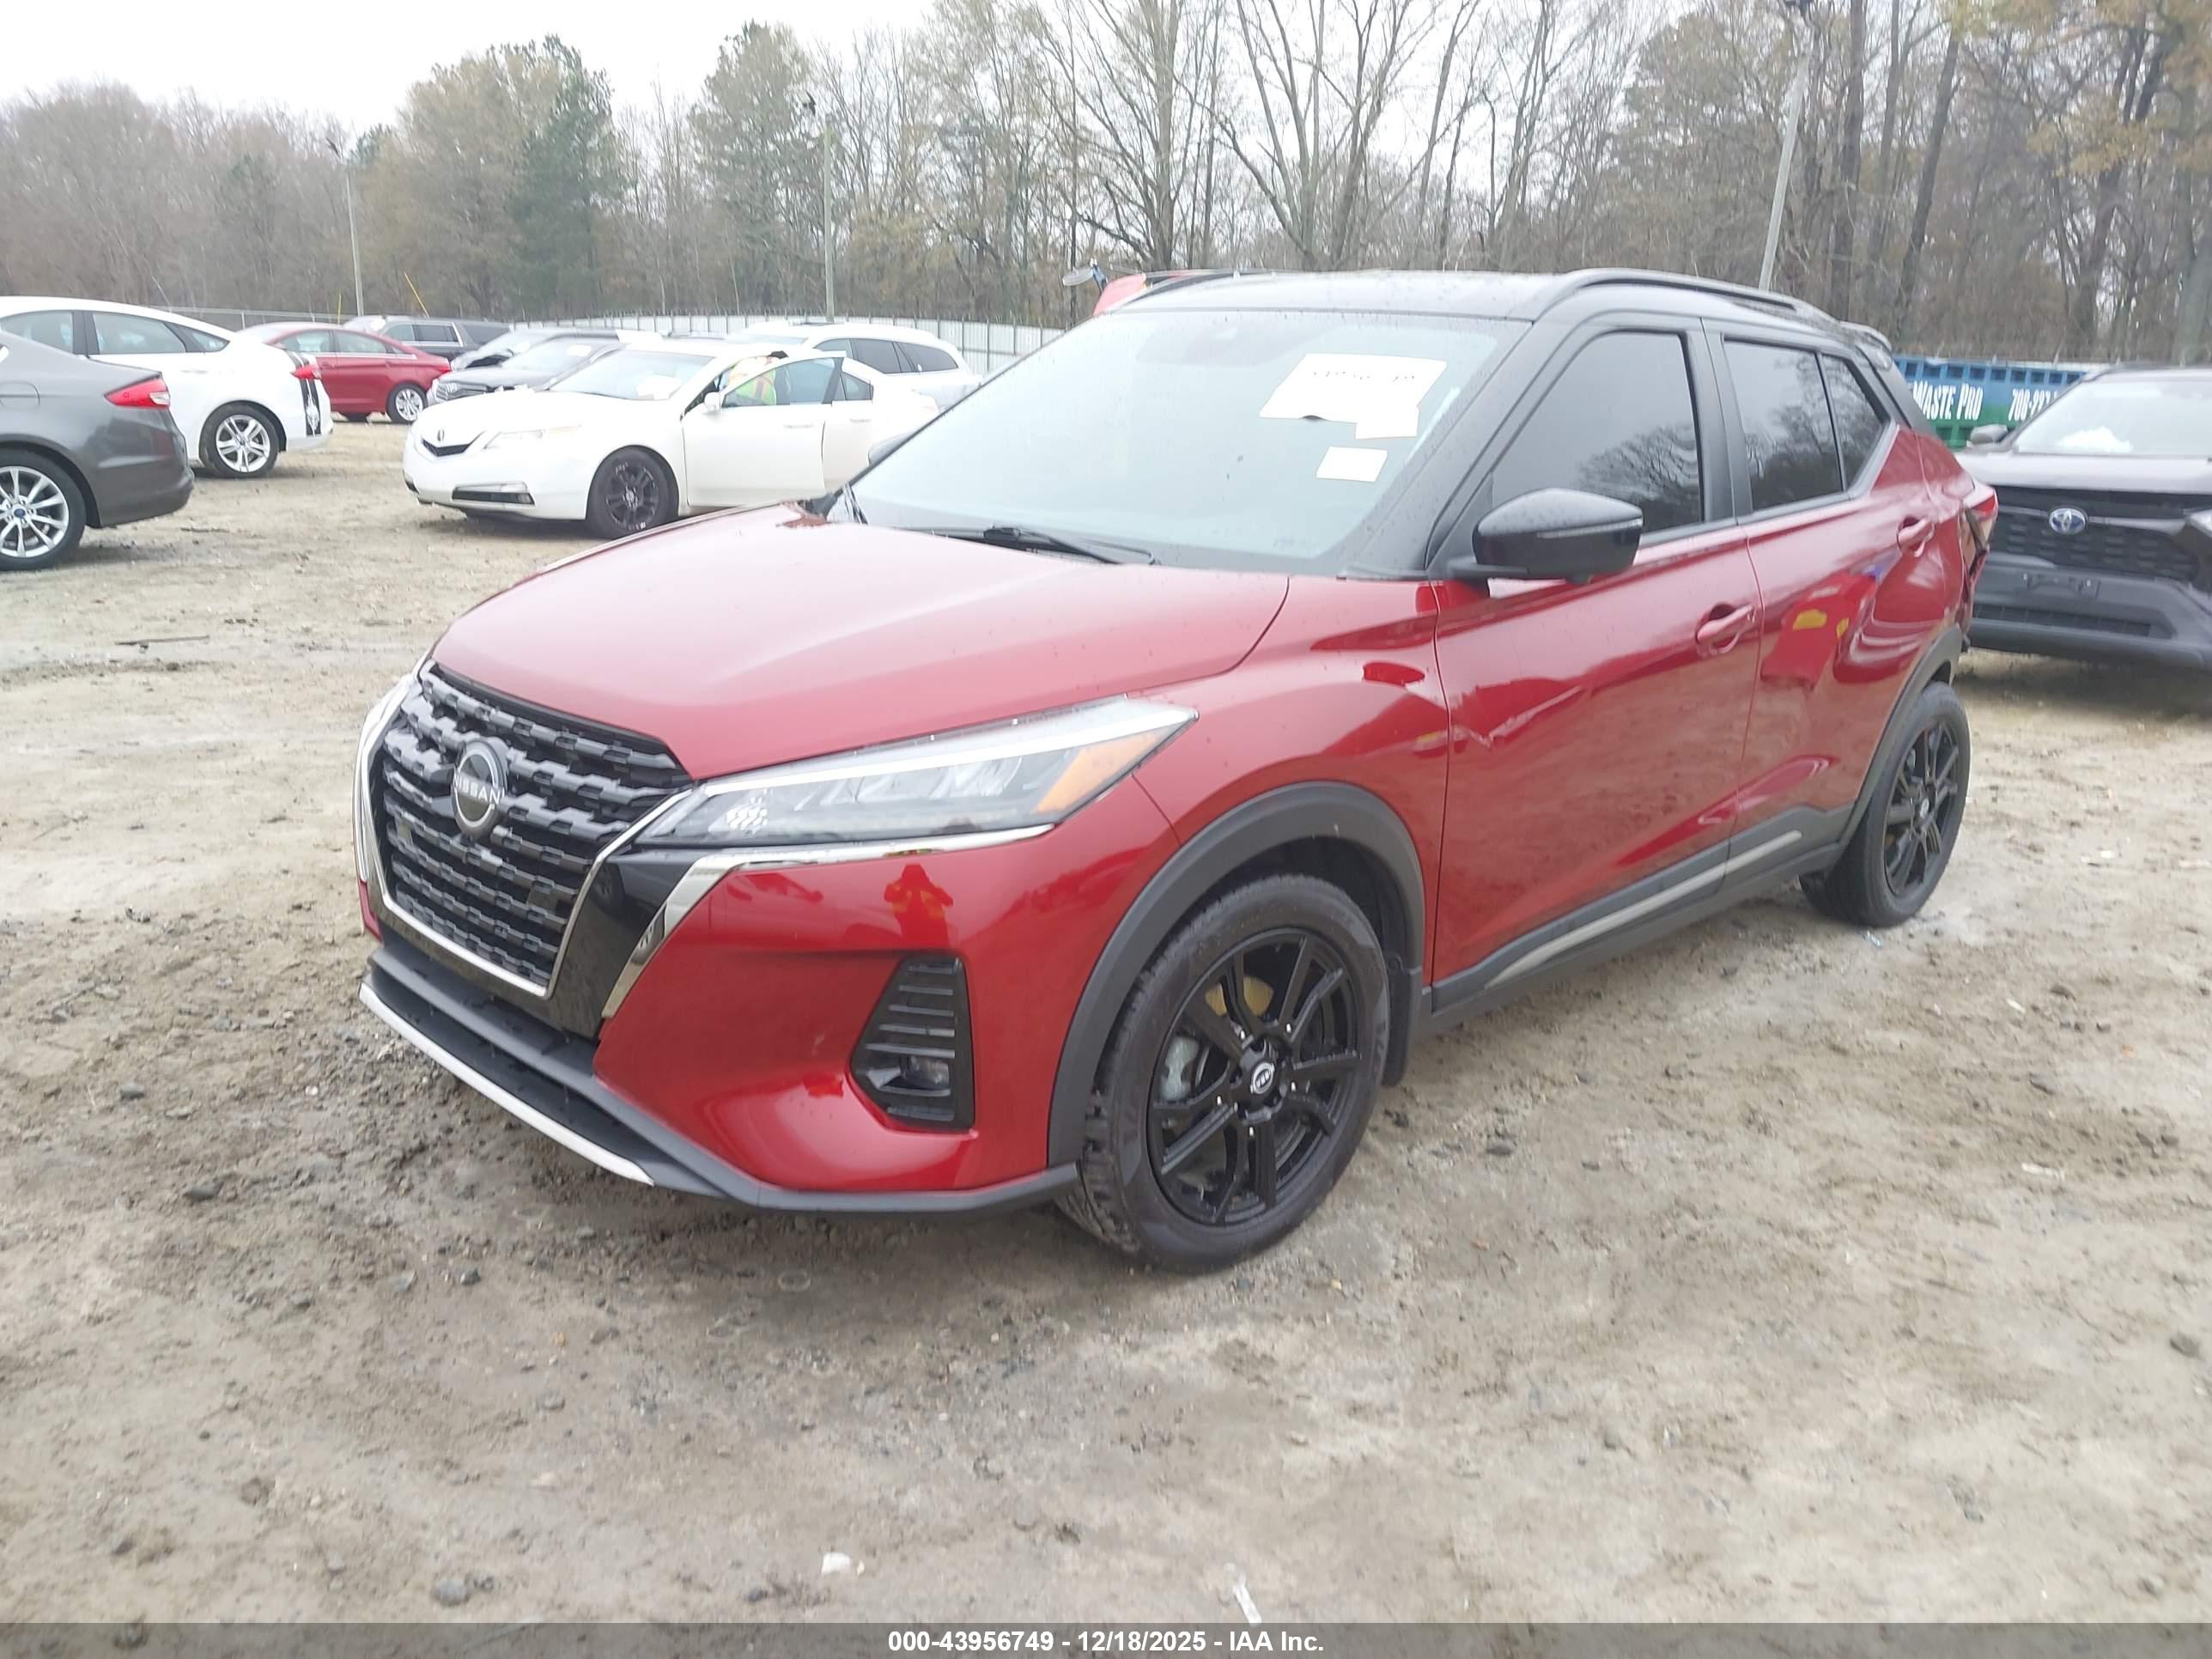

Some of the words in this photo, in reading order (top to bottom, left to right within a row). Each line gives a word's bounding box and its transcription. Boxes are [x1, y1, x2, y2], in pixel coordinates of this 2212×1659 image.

[1912, 380, 1955, 421] WASTE
[1956, 382, 1984, 421] PRO
[453, 773, 501, 805] NISSAN
